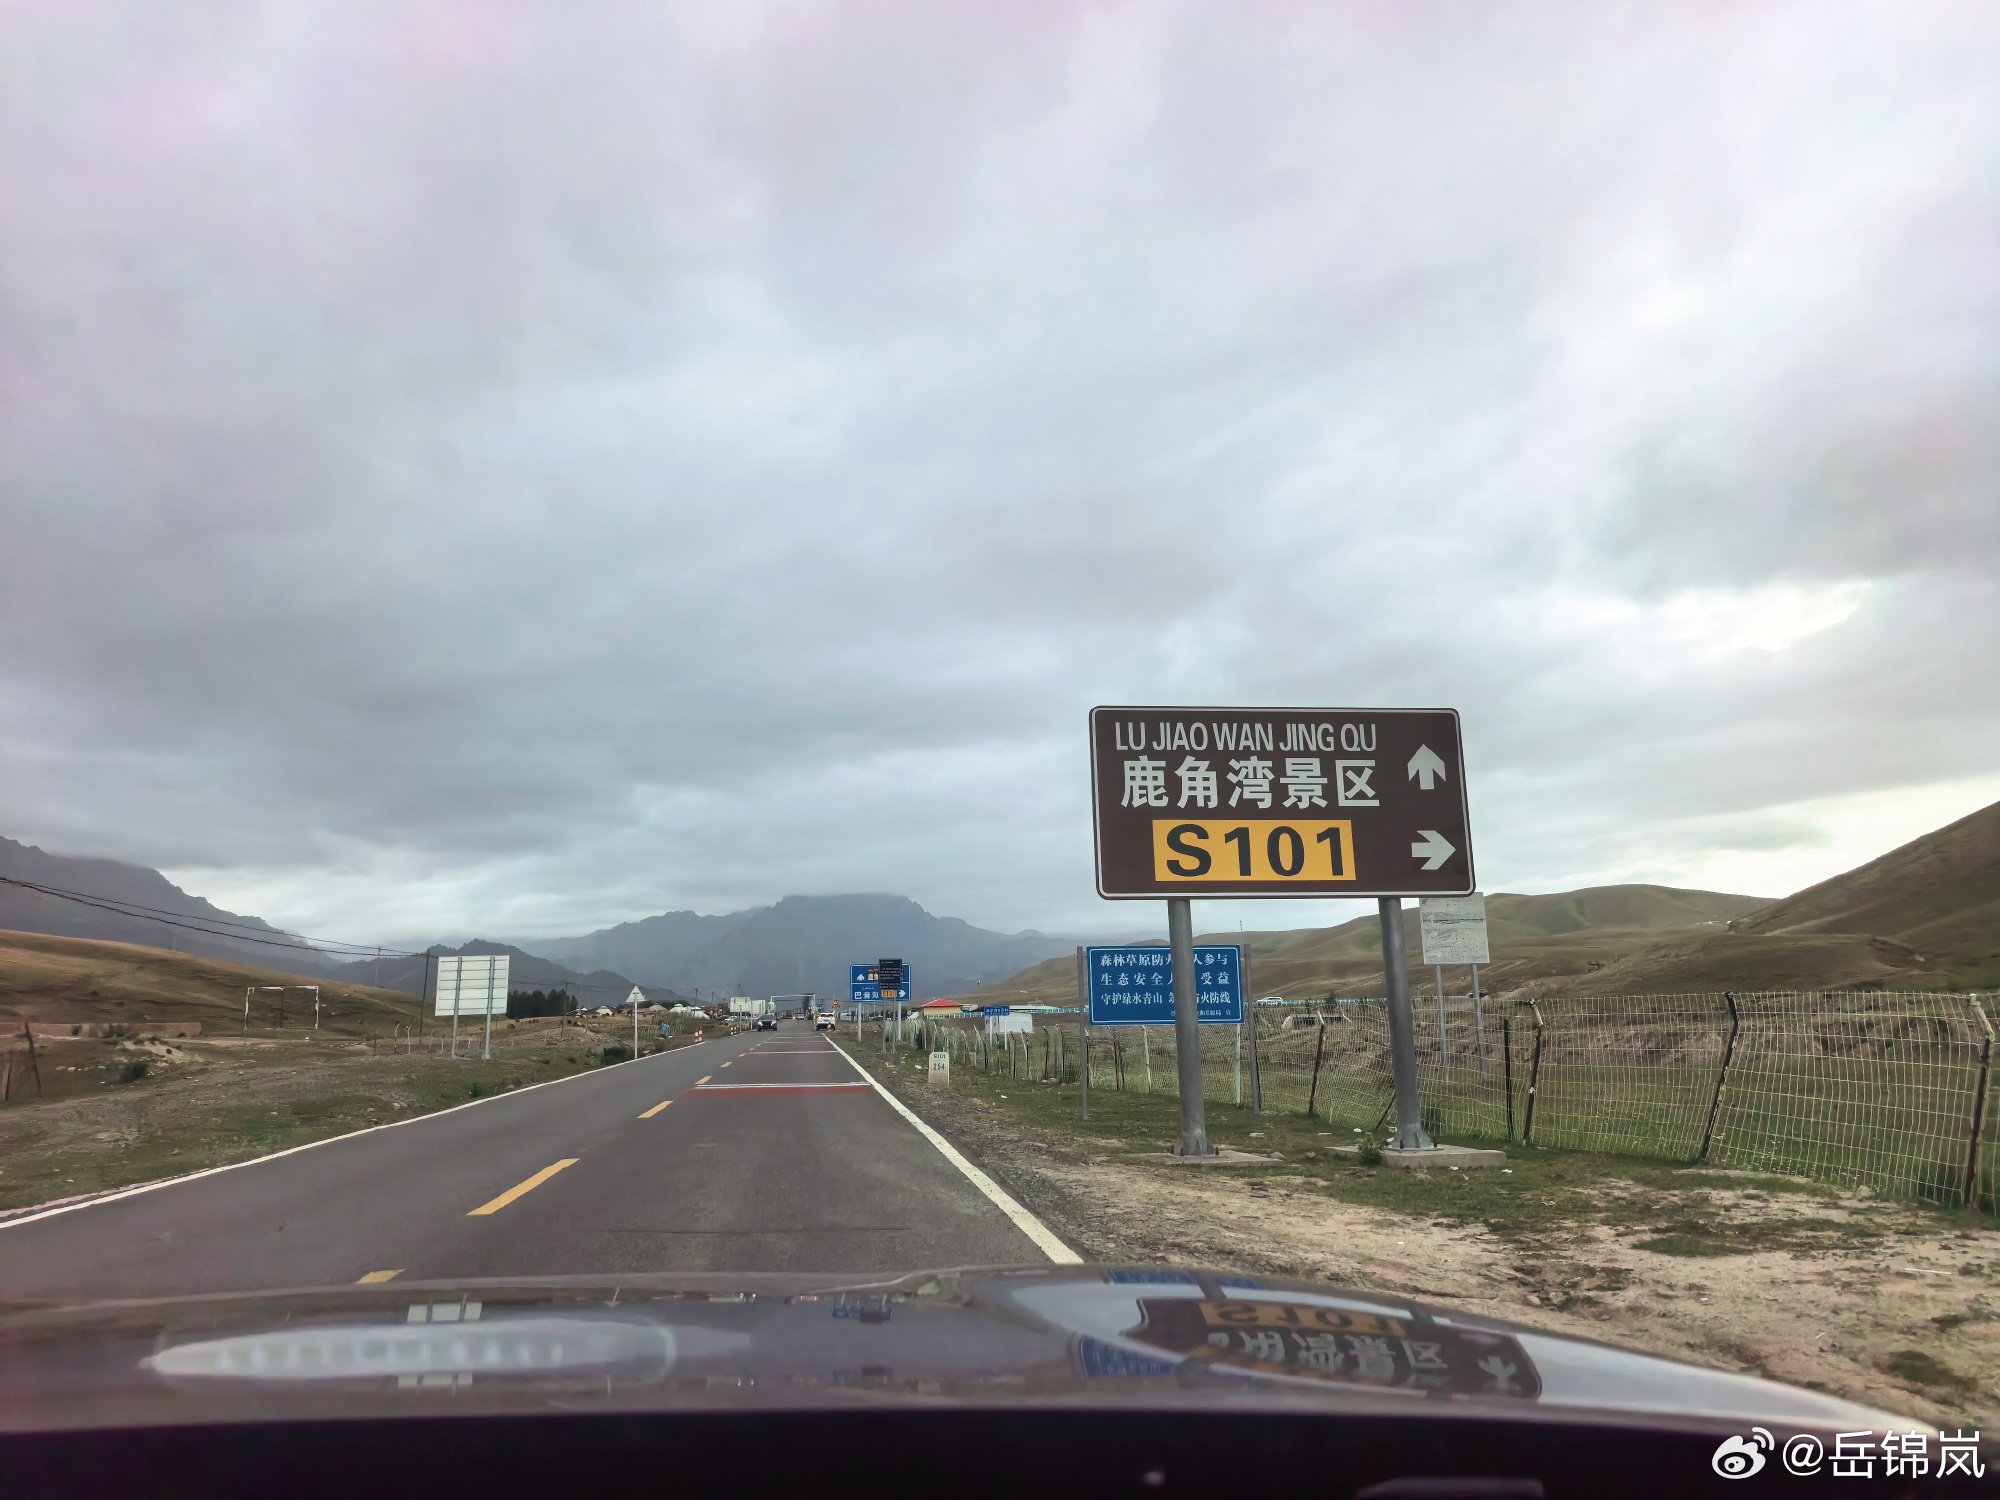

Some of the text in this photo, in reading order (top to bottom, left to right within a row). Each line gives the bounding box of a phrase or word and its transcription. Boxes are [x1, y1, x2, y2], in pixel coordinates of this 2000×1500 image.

[1115, 722, 1377, 752] LU JIAO WAN JING QU
[1120, 755, 1380, 809] 鹿角湾景区
[1165, 823, 1345, 877] S101
